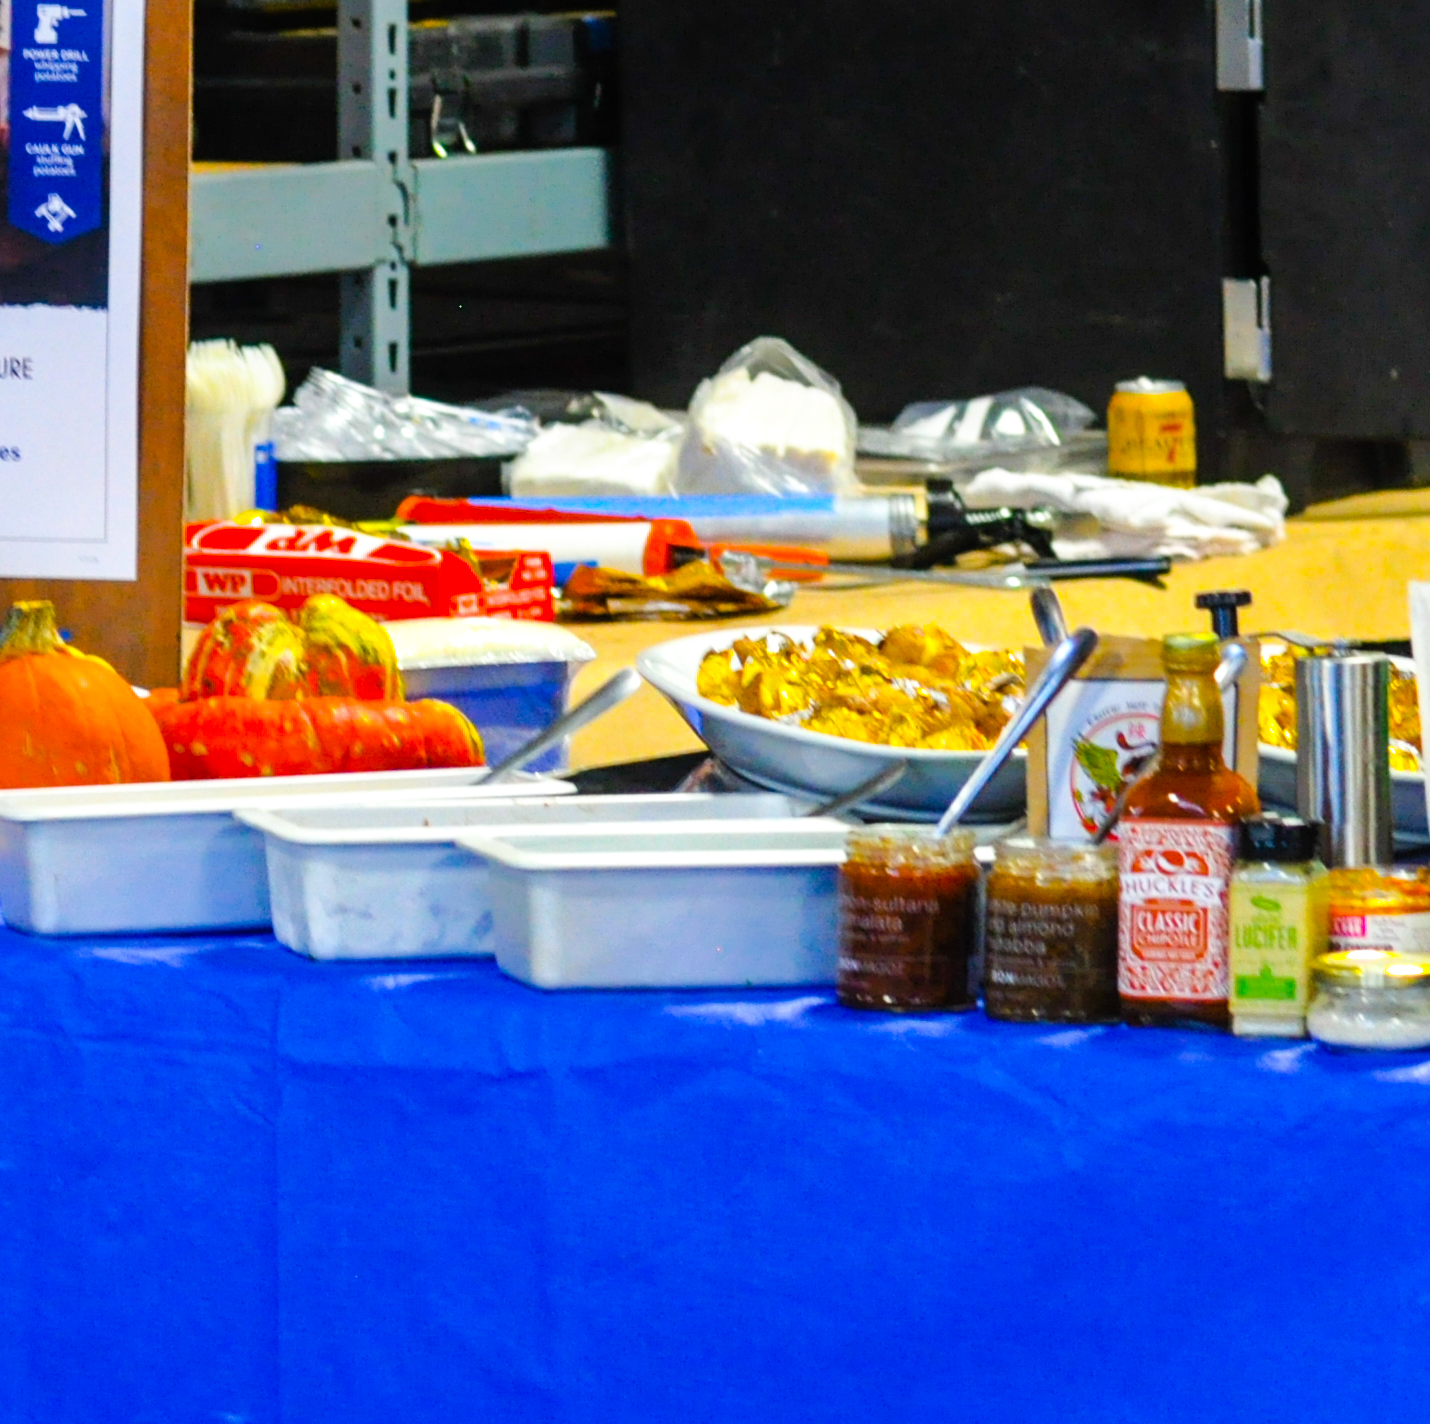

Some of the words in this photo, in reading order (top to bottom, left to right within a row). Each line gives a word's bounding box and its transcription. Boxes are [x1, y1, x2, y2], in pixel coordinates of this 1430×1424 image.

[200, 573, 250, 594] WP
[281, 575, 390, 600] INTERFOLDED
[1125, 877, 1218, 899] HUCKLE'S
[1137, 911, 1199, 935] CLASSIC
